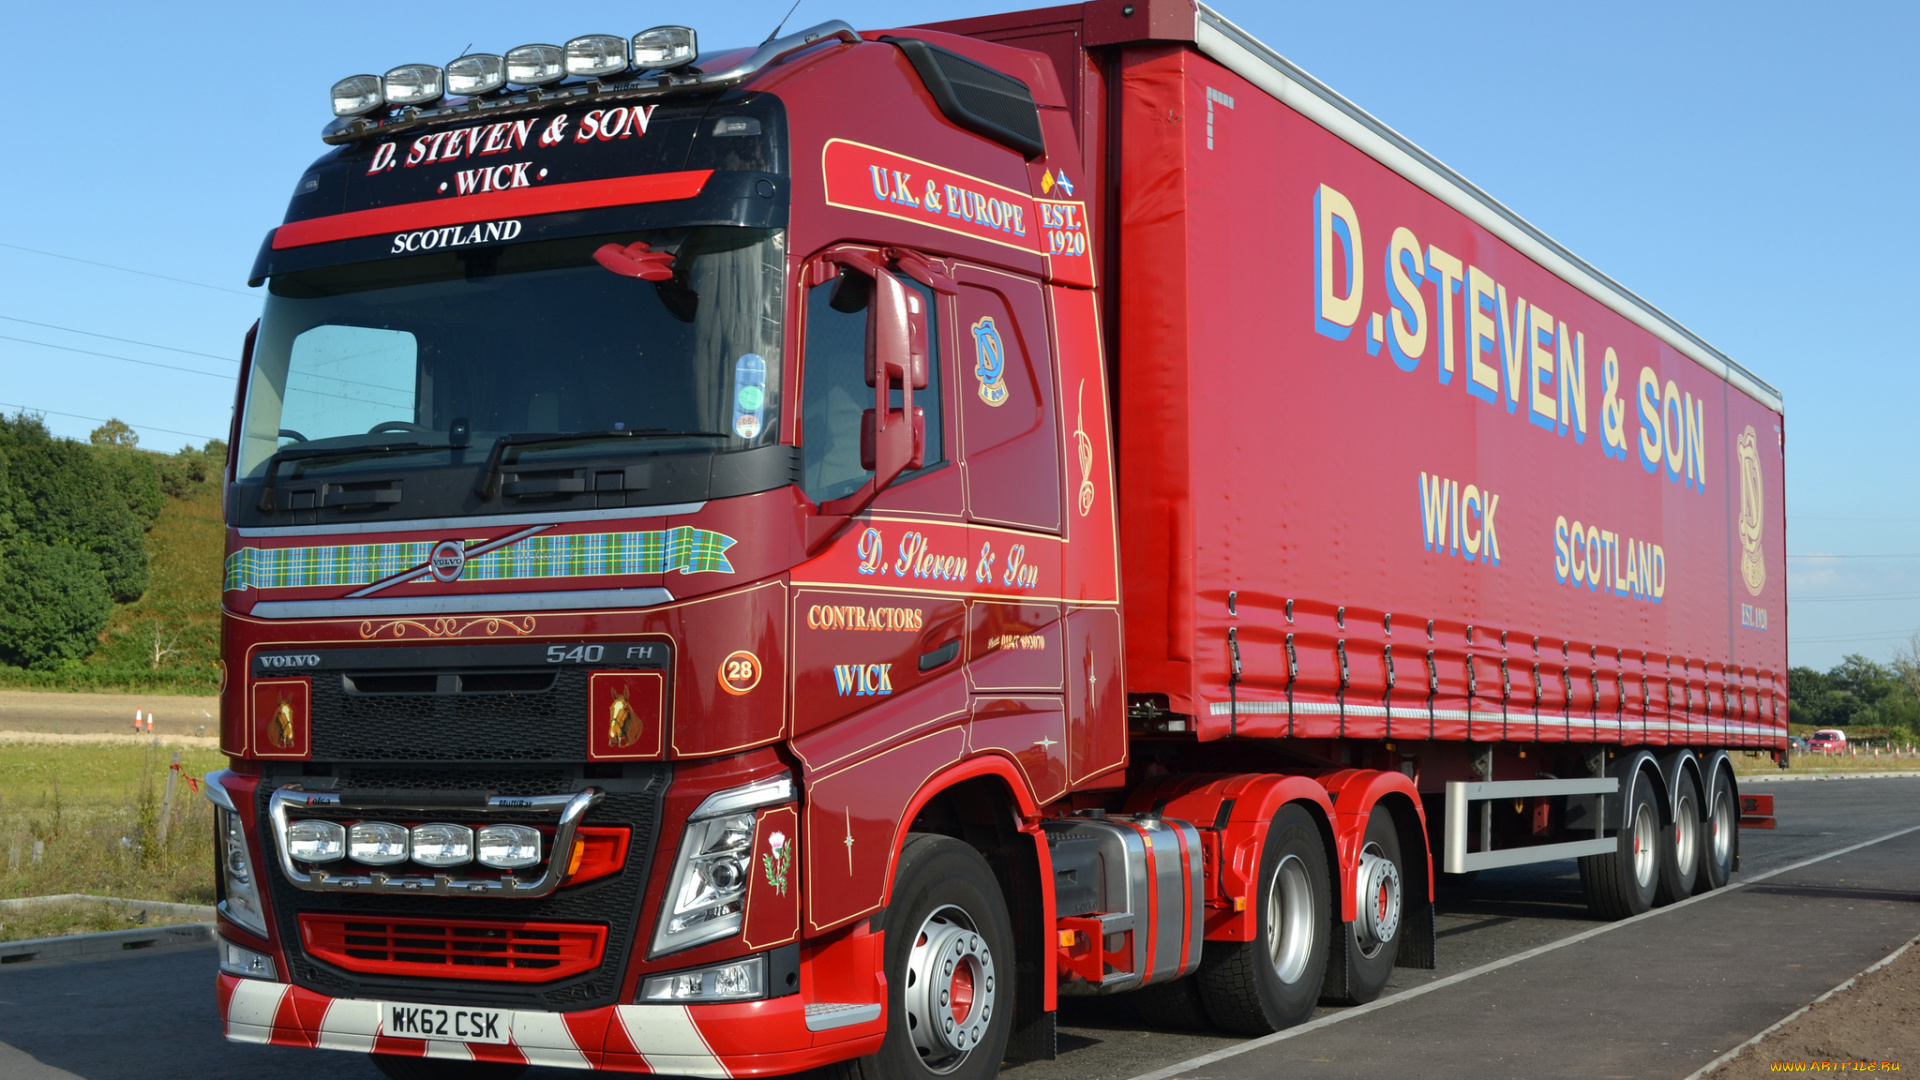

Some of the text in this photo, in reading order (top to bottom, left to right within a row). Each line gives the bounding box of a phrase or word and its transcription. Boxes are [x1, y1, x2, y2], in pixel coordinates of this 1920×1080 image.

[367, 104, 659, 174] D. STEVEN & SON
[455, 162, 532, 195] WICK
[870, 165, 1026, 236] U.K. & EUROPE
[1041, 204, 1081, 229] EST.
[391, 220, 521, 253] SCOTLAND
[1048, 230, 1085, 256] 1920
[1313, 183, 1705, 494] D.STEVEN & SON
[1418, 470, 1501, 567] WICK
[433, 558, 462, 566] VOLVO
[858, 527, 1038, 588] D. Steven & Son
[1554, 516, 1665, 604] SCOTLAND
[807, 605, 923, 632] CONTRACTORS
[259, 654, 321, 668] VOLVO
[546, 645, 653, 663] 540 FH
[727, 661, 752, 680] 28
[833, 663, 893, 696] WICK
[392, 1006, 499, 1039] WK62 CSK
